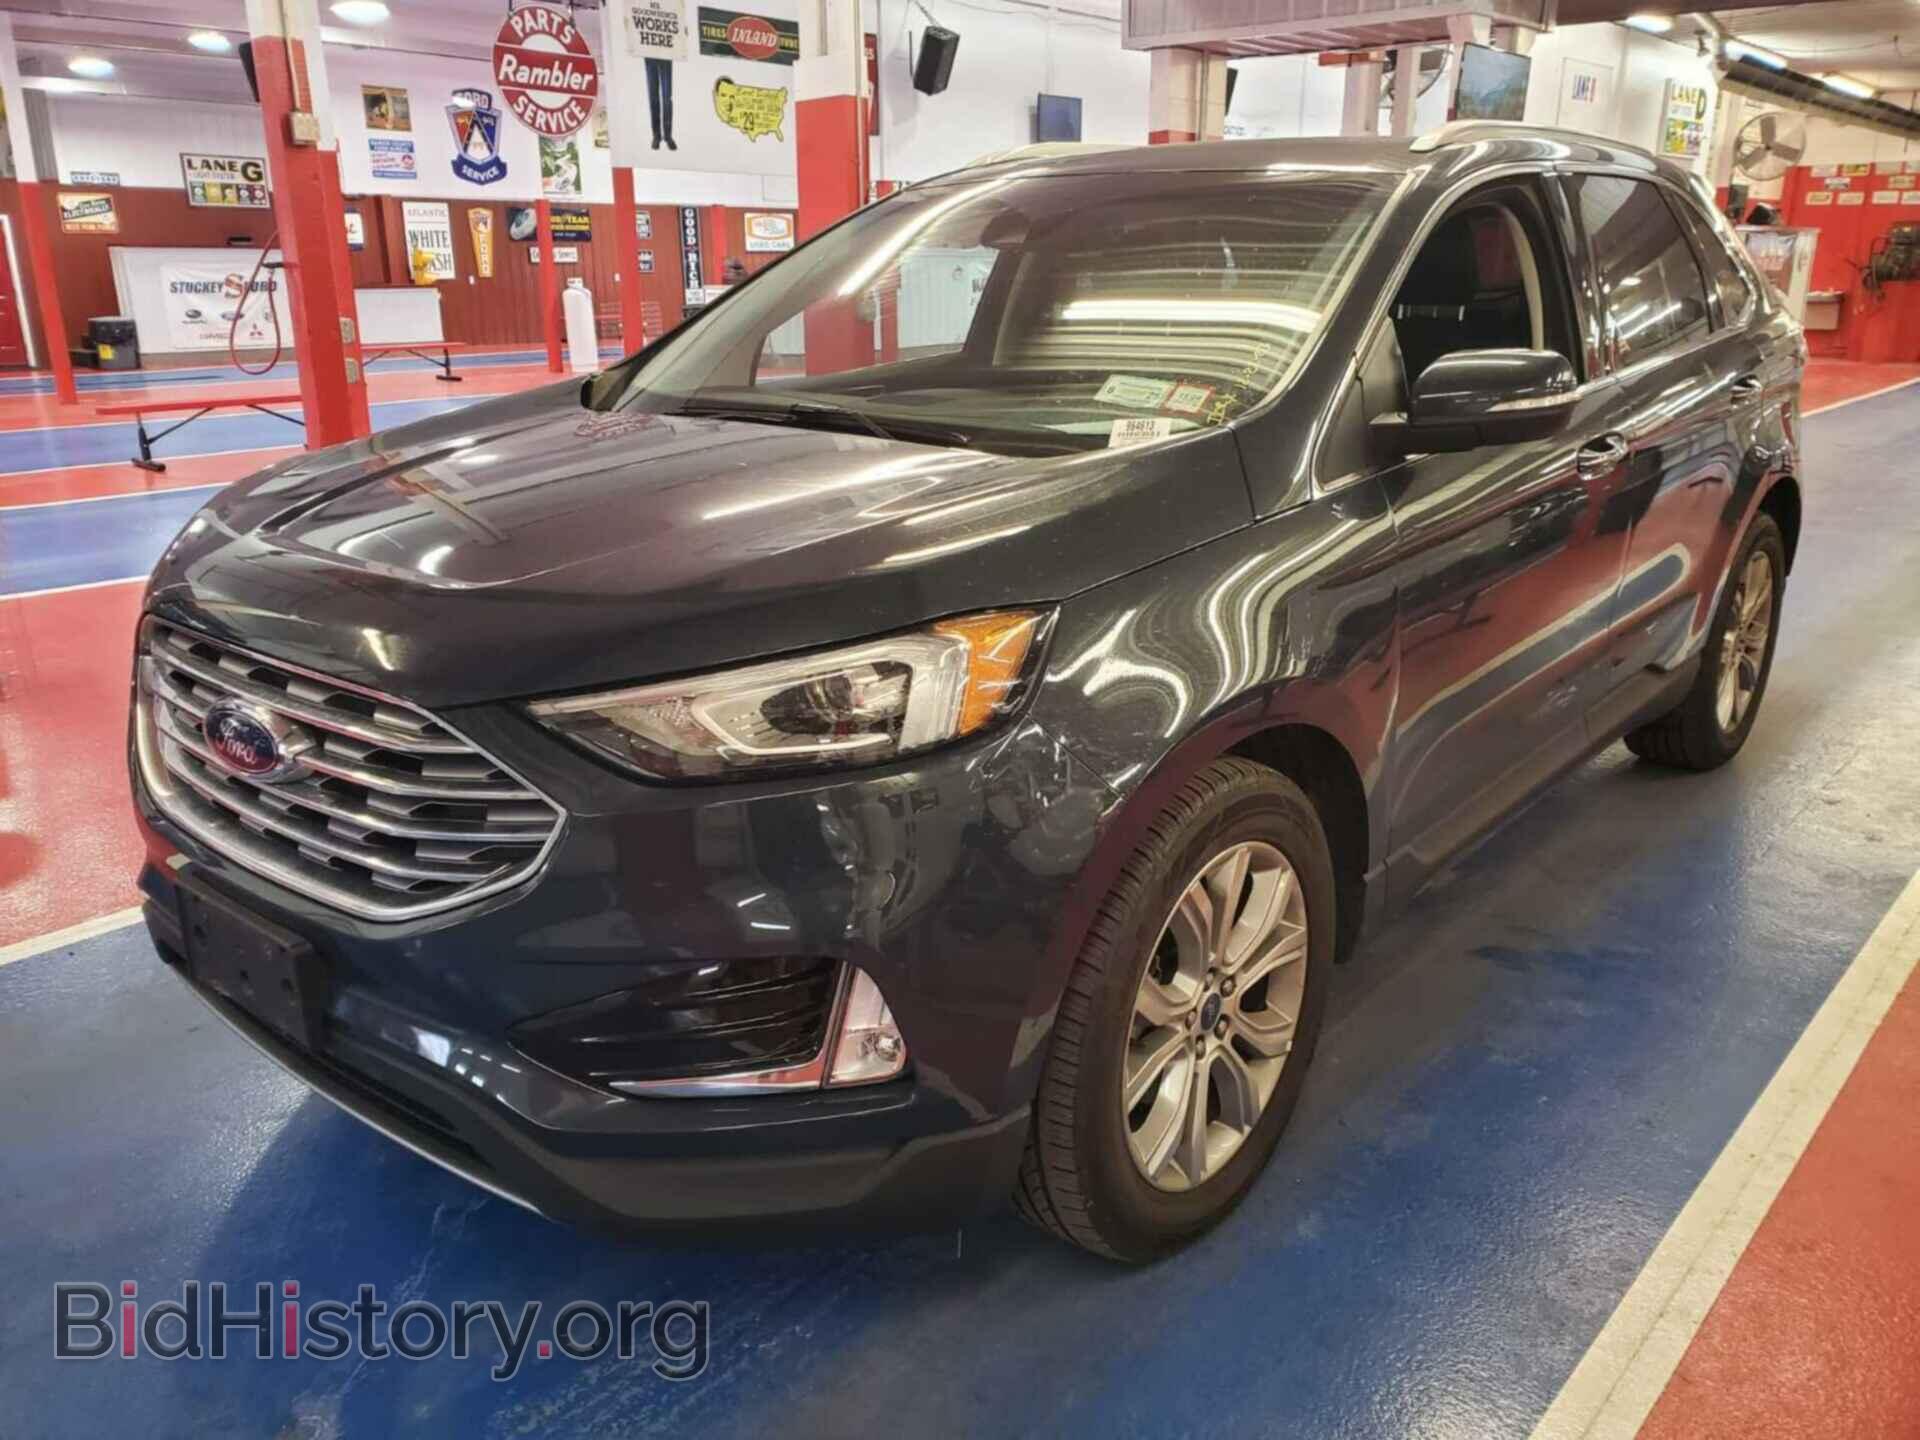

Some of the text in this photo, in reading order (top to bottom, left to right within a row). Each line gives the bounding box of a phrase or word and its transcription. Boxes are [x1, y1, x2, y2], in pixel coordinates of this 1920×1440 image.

[510, 8, 576, 44] PARTS
[632, 16, 679, 34] WORKS
[640, 31, 673, 48] HERE
[731, 27, 778, 48] INLAND
[499, 54, 594, 91] Rambler
[455, 92, 490, 109] ORD
[512, 94, 586, 133] SERVICE
[186, 158, 264, 182] LANE G
[408, 230, 450, 249] WHITE
[424, 253, 453, 272] ASH
[169, 281, 224, 294] STUCKEY
[220, 718, 257, 764] Ford
